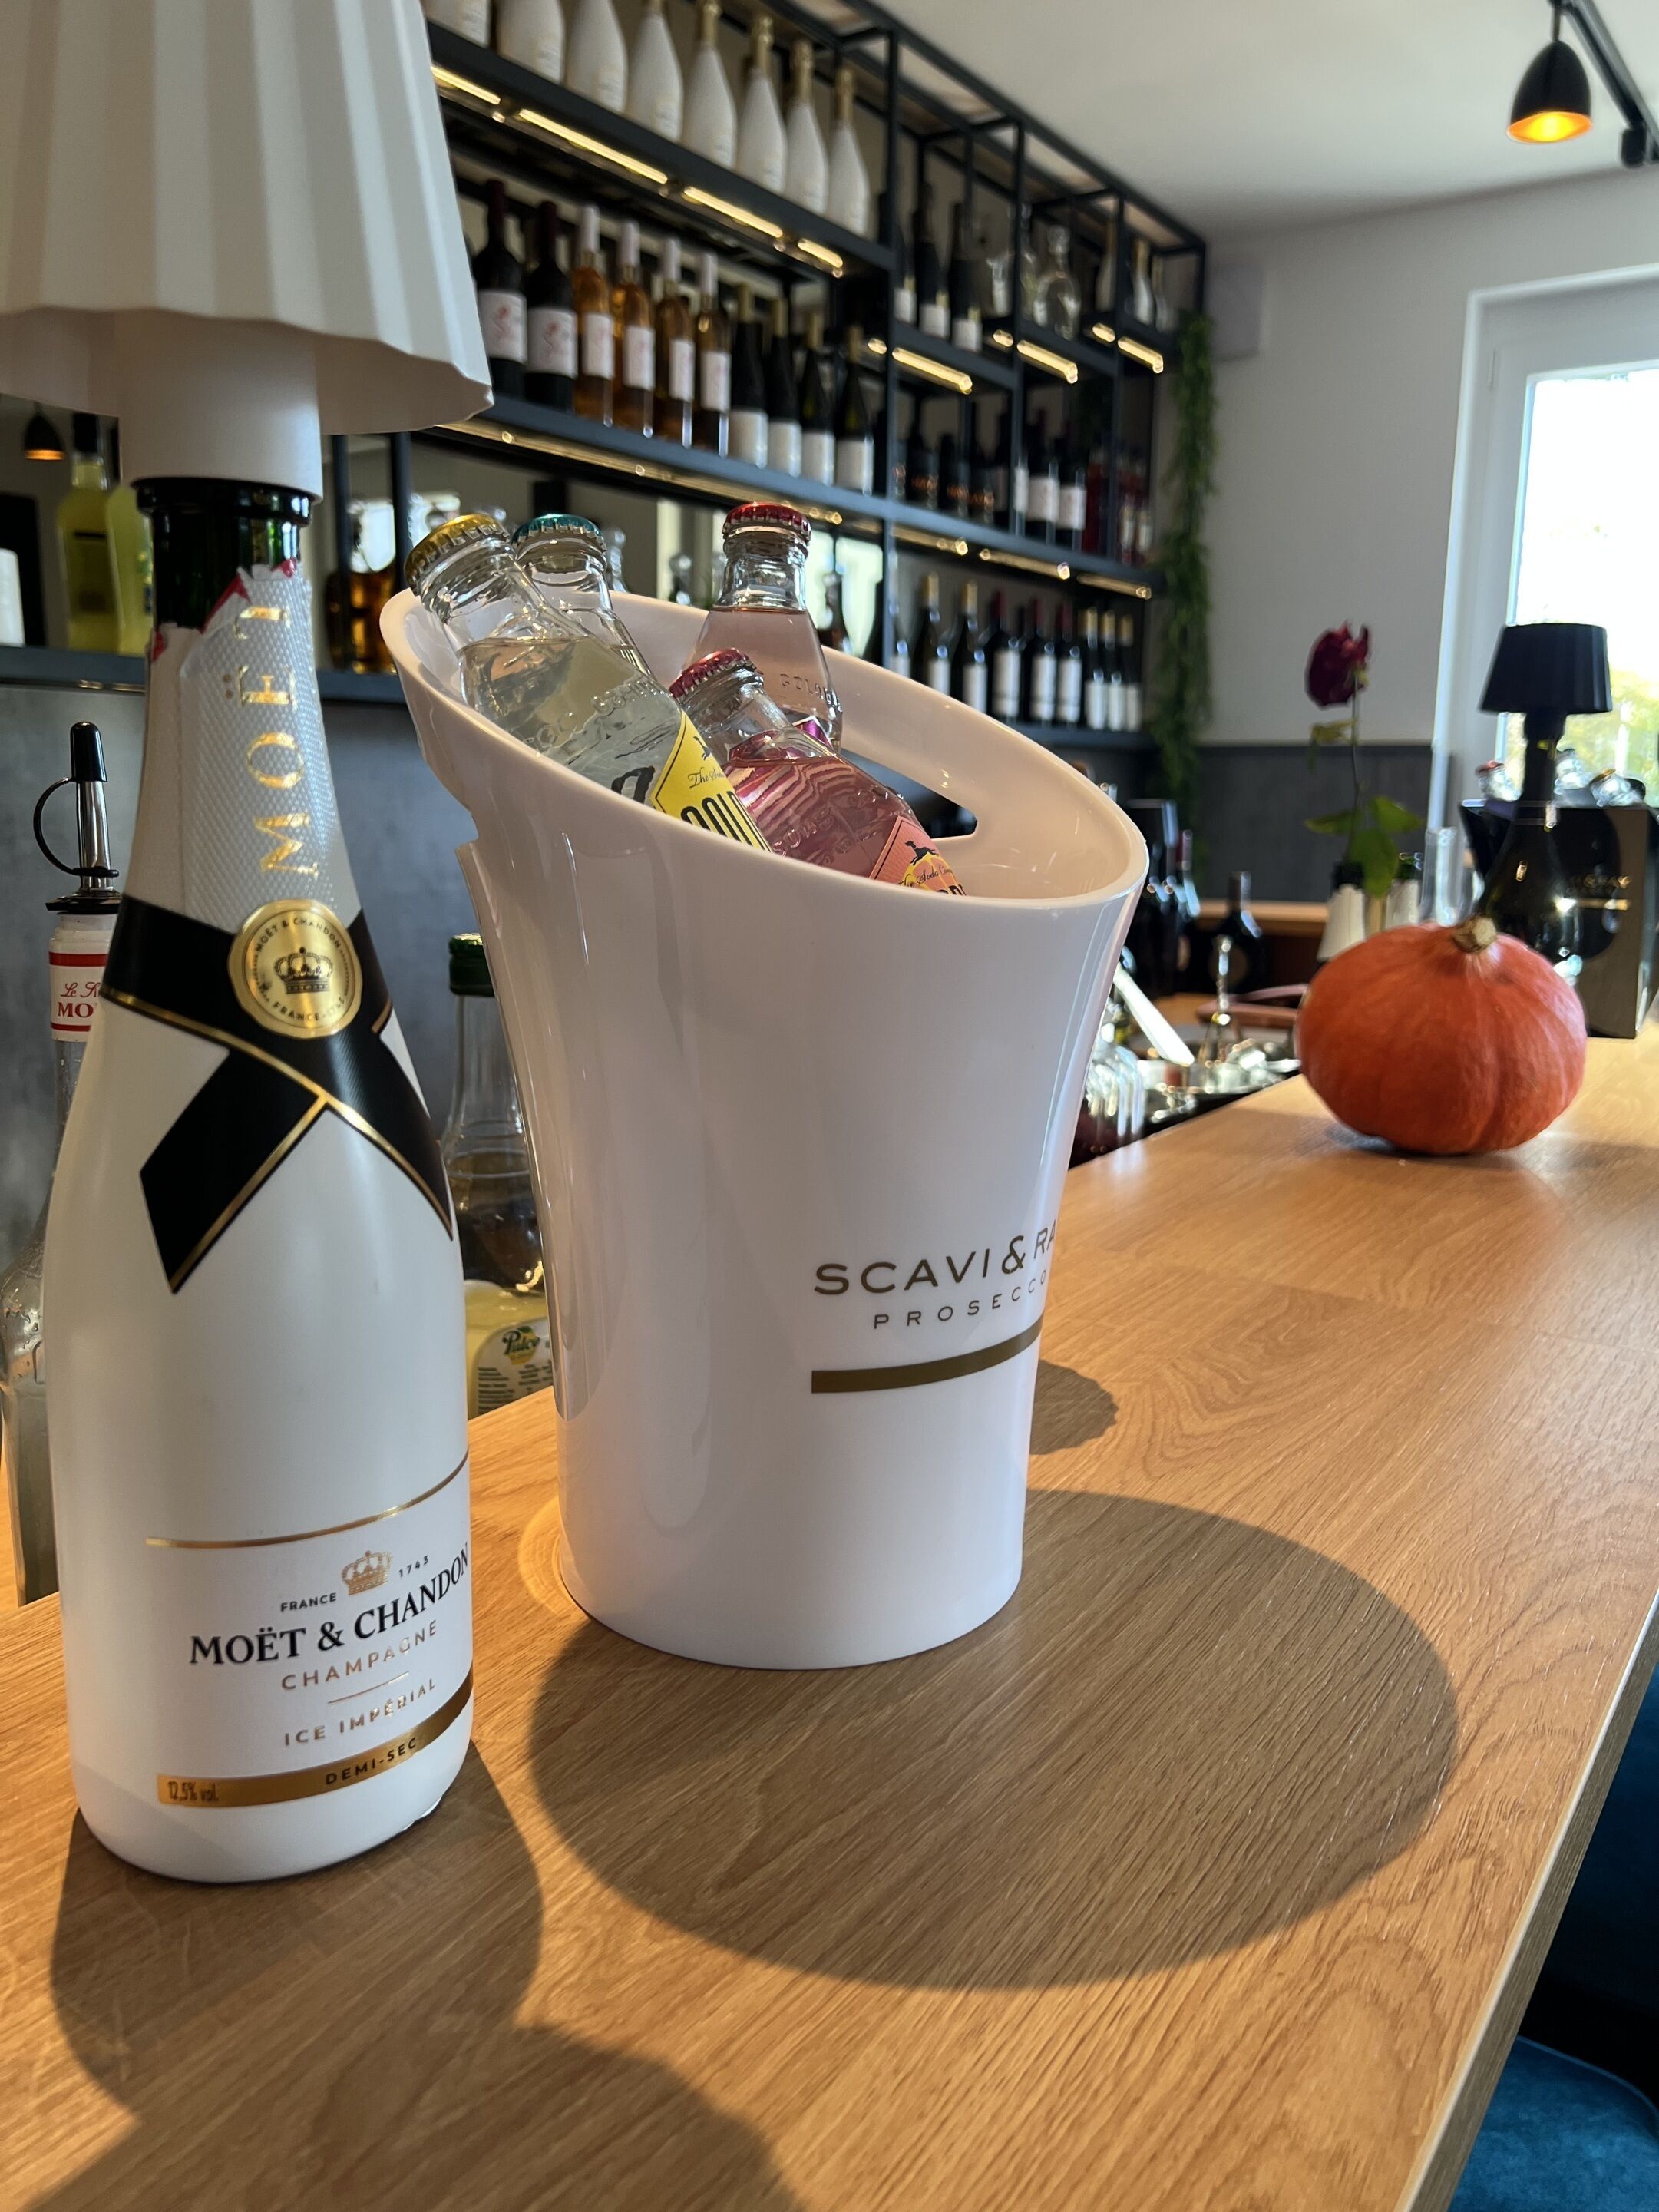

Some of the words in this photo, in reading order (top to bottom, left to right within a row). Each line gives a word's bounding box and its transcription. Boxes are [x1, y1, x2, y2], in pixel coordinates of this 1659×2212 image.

[223, 606, 319, 880] MOËT
[688, 767, 709, 789] The
[293, 917, 342, 949] CHANDON
[57, 1001, 97, 1018] MO
[60, 983, 78, 997] Le
[273, 1001, 320, 1021] FRANCE
[814, 1248, 990, 1294] SCAVI
[1001, 1235, 1026, 1275] &
[874, 1269, 1046, 1329] PROSECCO
[398, 1555, 429, 1578] 1743
[190, 1626, 306, 1665] MOËT
[317, 1621, 345, 1652] &
[354, 1542, 468, 1640] CHANDON
[281, 1592, 337, 1612] FRANCE
[282, 1620, 437, 1691] CHAMPAGNE
[285, 1724, 326, 1747] ICE
[339, 1677, 436, 1734] IMPÉRIAL
[325, 1737, 418, 1785] DEMI-SEC
